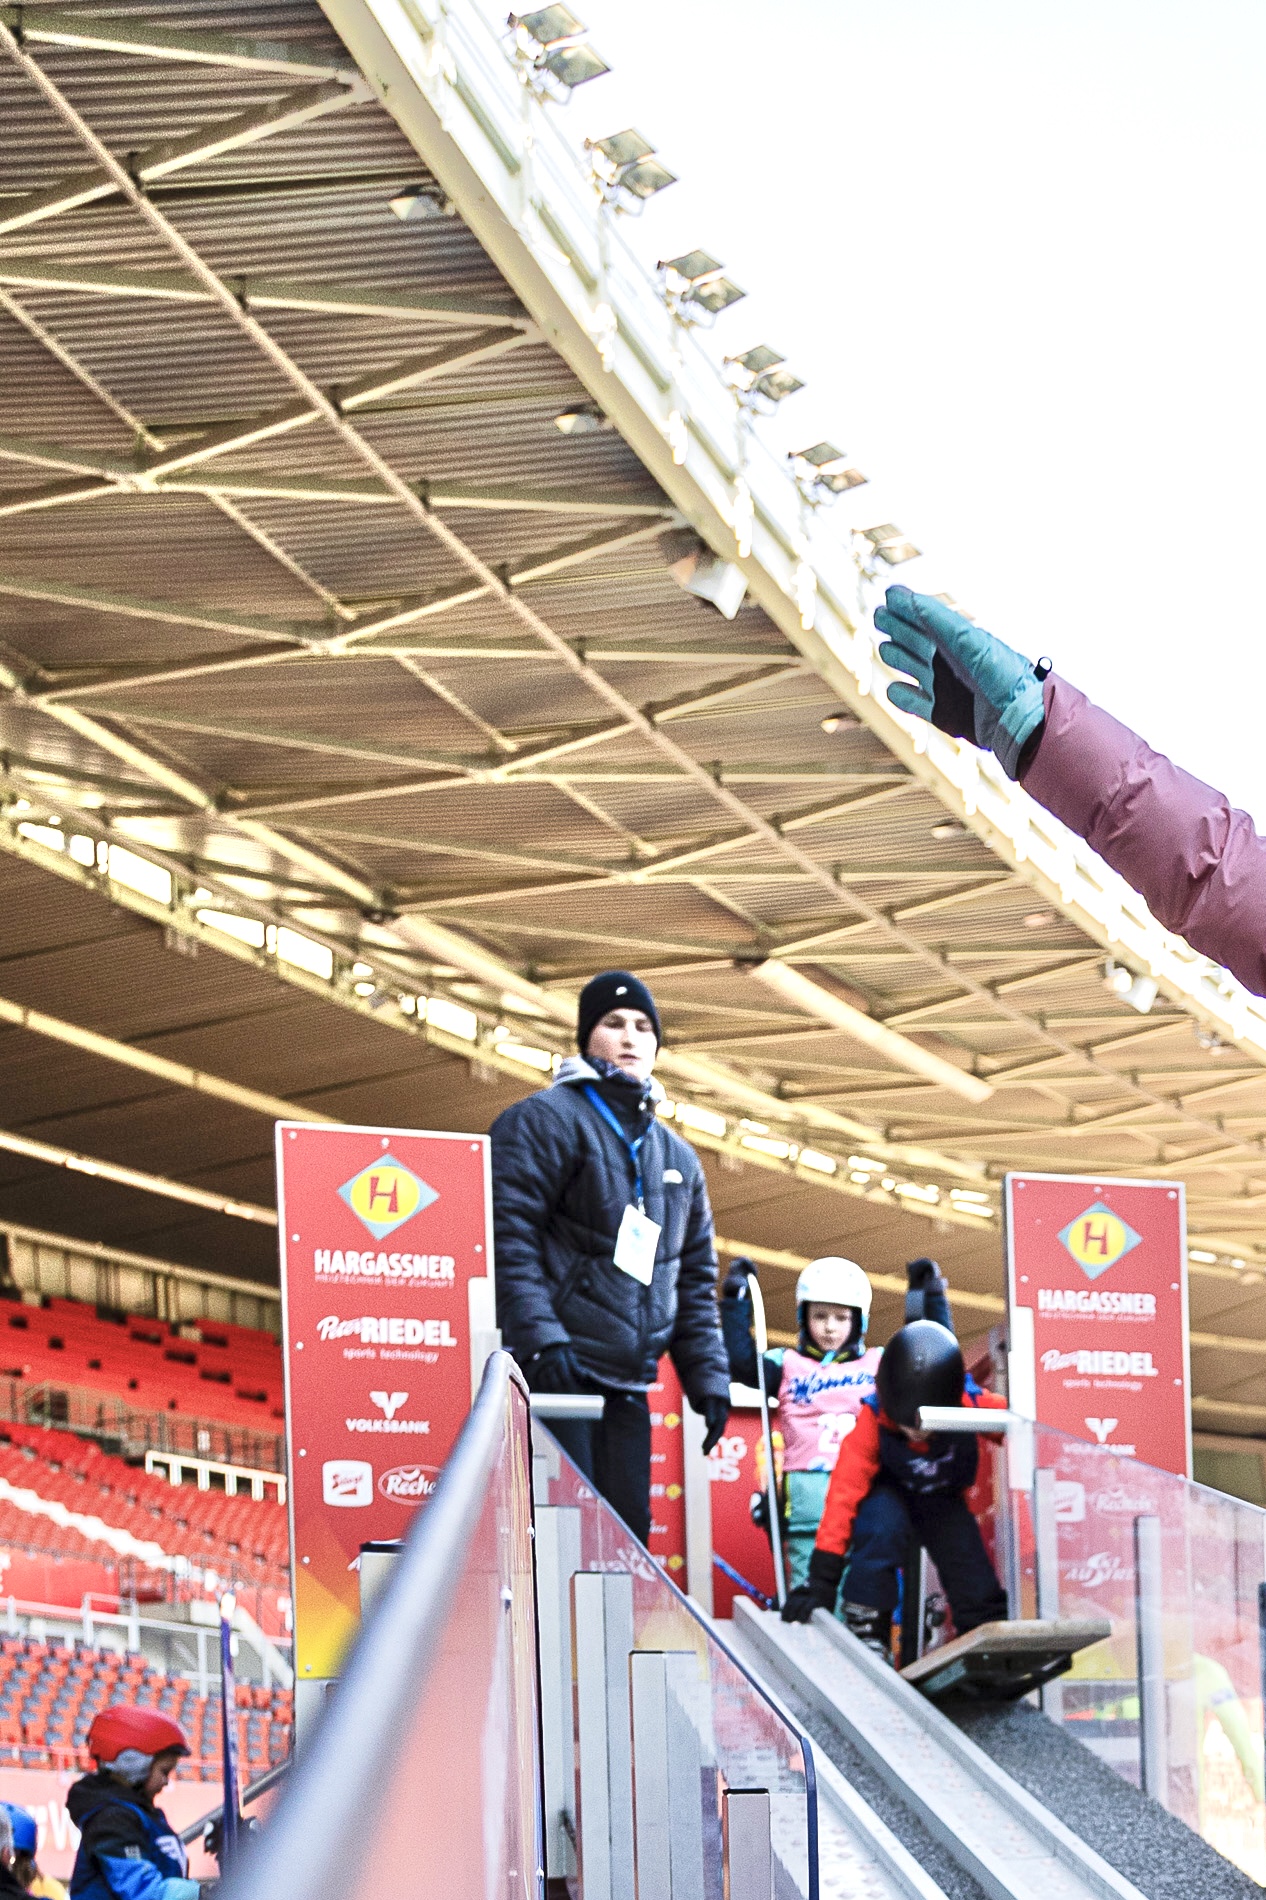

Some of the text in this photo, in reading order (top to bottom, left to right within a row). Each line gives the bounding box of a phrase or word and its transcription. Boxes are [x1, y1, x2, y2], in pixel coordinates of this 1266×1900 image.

[314, 1249, 455, 1280] HARGASSNER
[1037, 1289, 1157, 1315] HARGASSNER
[360, 1316, 458, 1347] RIEDEL
[1077, 1349, 1159, 1377] RIEDEL
[345, 1418, 431, 1435] VOLKSBANK
[385, 1473, 438, 1497] Reche
